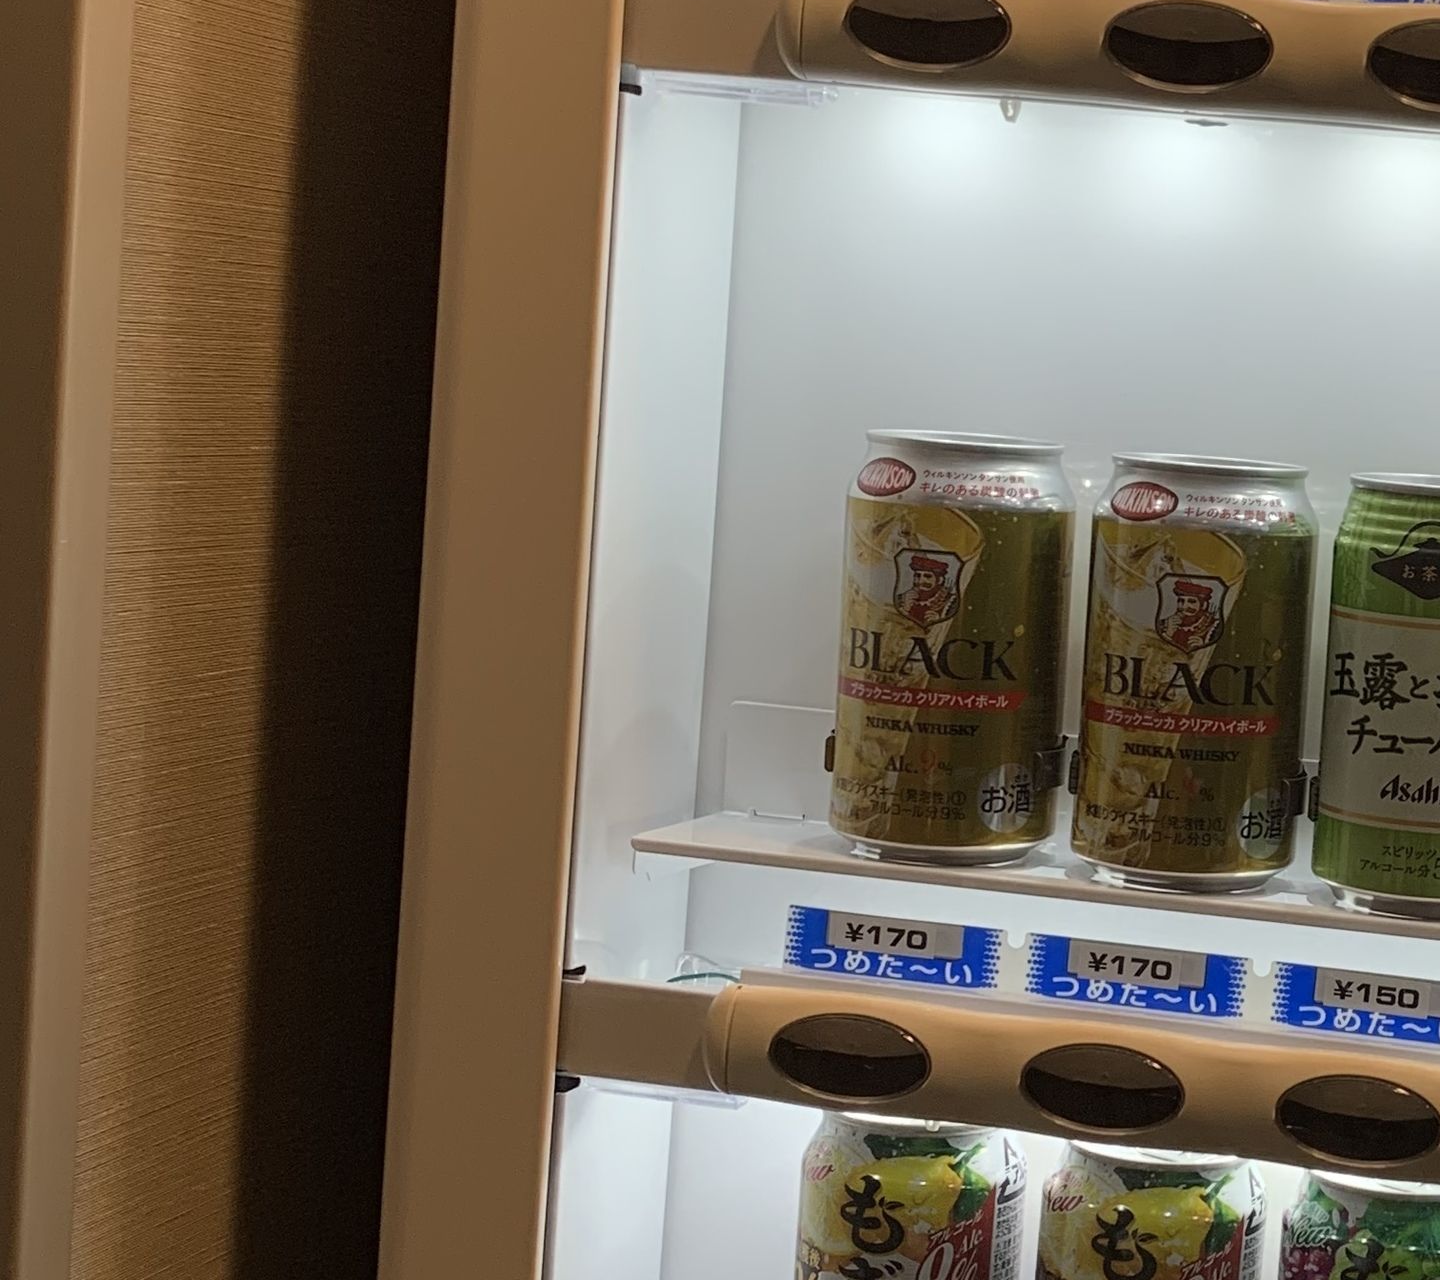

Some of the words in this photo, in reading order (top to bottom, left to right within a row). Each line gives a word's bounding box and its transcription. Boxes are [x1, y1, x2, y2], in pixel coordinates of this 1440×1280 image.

[849, 626, 1018, 682] BLACK
[1103, 652, 1275, 707] BLACK
[916, 691, 1009, 710] クリアハイボール
[865, 715, 914, 734] NIKKA
[916, 722, 980, 738] WHISKY
[1104, 708, 1176, 730] ブラックニッカ
[1179, 716, 1267, 734] クリアハイボール
[1122, 741, 1177, 759] NIKKA
[1179, 748, 1240, 763] WHISKY
[981, 782, 1031, 815] お酒
[1240, 806, 1285, 841] お酒
[844, 922, 928, 951] ¥170
[1087, 951, 1173, 982] ¥170
[1332, 978, 1420, 1010] ¥150
